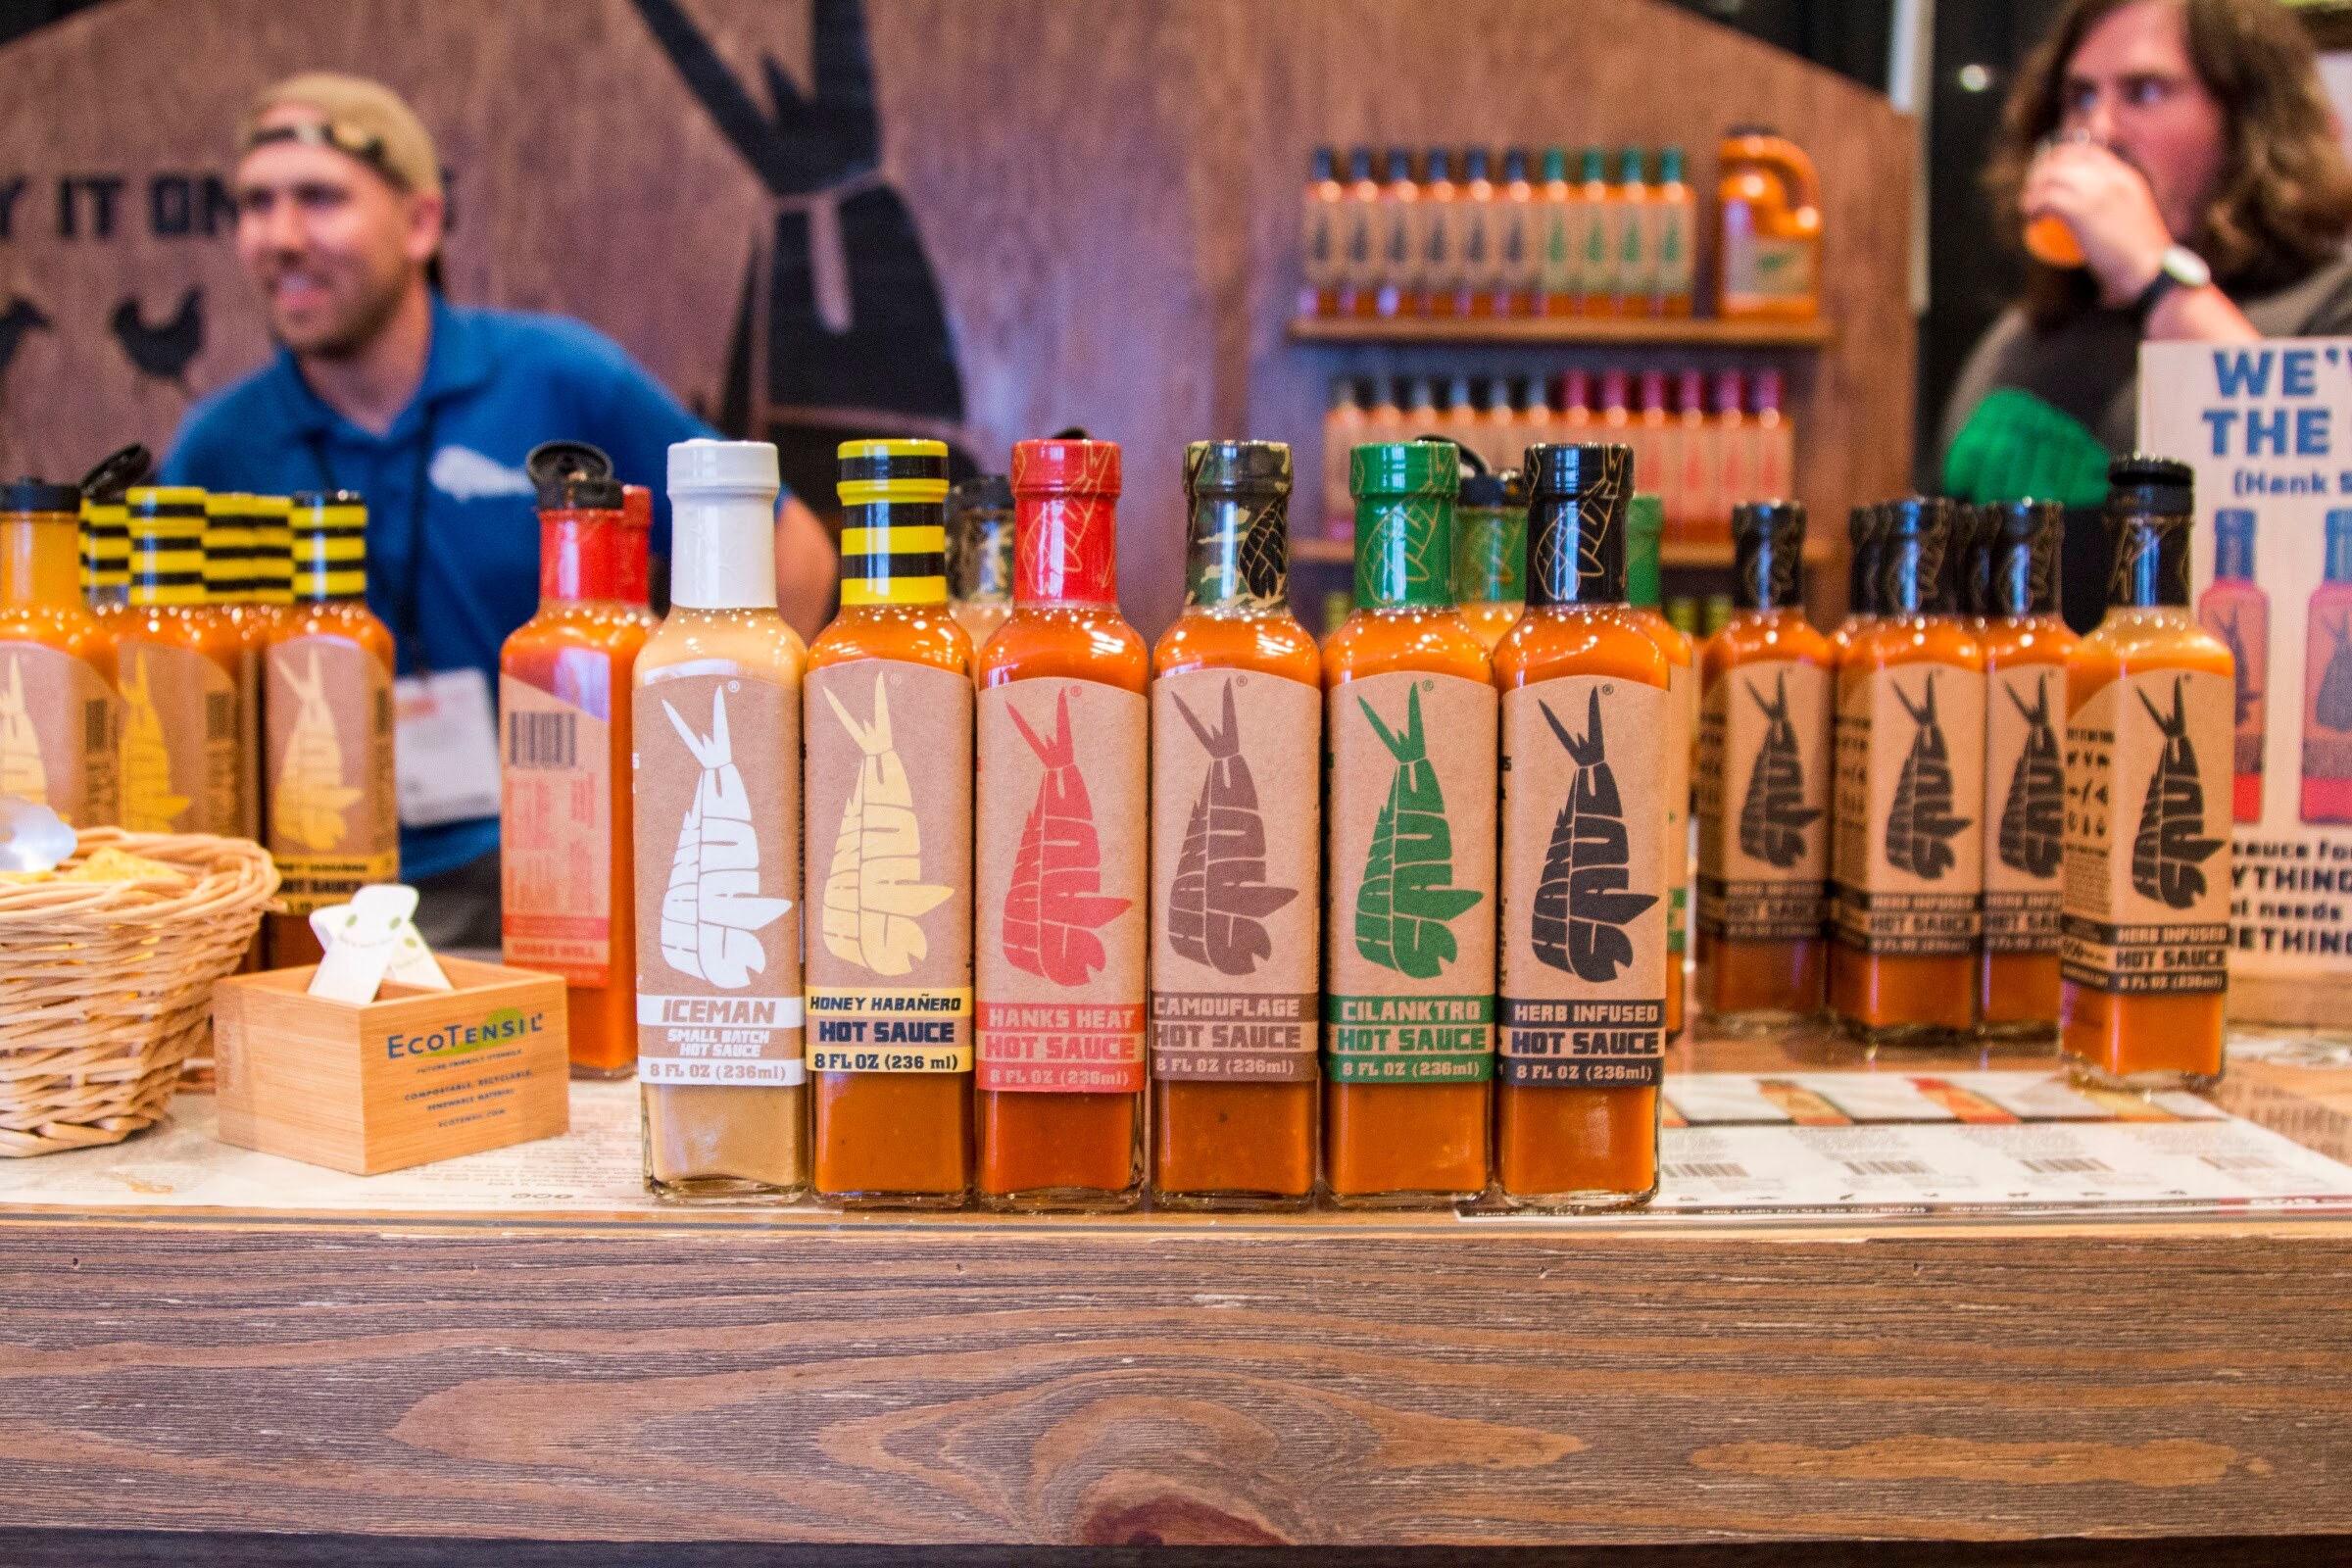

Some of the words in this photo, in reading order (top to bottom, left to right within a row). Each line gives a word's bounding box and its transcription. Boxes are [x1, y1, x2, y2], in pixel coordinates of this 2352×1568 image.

[59, 174, 125, 239] IT
[2202, 408, 2329, 456] THE
[2117, 951, 2155, 967] HOT
[2163, 951, 2225, 966] SAUCE
[810, 996, 867, 1010] HONEY
[870, 993, 961, 1011] HABAÑERO
[1153, 997, 1299, 1017] CAMOUFLAGE
[1342, 1001, 1481, 1021] CILANKTRO
[662, 1000, 776, 1024] ICEMAN
[989, 1008, 1070, 1028] HANKS
[1077, 1009, 1135, 1029] HEAT
[1514, 1004, 1568, 1022] HERB
[1573, 1005, 1658, 1022] INFUSED
[667, 1029, 718, 1042] SMALL
[721, 1031, 770, 1044] BATCH
[819, 1021, 867, 1043] HOT
[874, 1022, 955, 1043] SAUCE
[1152, 1024, 1204, 1048] HOT
[1212, 1025, 1300, 1049] SAUCE
[1338, 1029, 1391, 1052] HOT
[1398, 1029, 1486, 1051] SAUCE
[679, 1044, 710, 1056] HOT
[712, 1044, 760, 1057] SAUCE
[985, 1035, 1039, 1058] HOT
[1047, 1036, 1135, 1059] SAUCE
[1512, 1032, 1566, 1054] HOT
[1572, 1032, 1658, 1054] SAUCE
[814, 1054, 825, 1069] 8
[829, 1054, 852, 1069] FL
[856, 1054, 879, 1069] OZ
[885, 1054, 924, 1070] (236
[930, 1054, 957, 1070] ml)
[1156, 1058, 1167, 1071] 8
[1171, 1058, 1192, 1072] FL
[1197, 1058, 1219, 1072] OZ
[1226, 1059, 1295, 1075] (236ml)
[1343, 1062, 1353, 1076] 8
[1358, 1062, 1379, 1076] FL
[1412, 1061, 1480, 1078] (236ml)
[650, 1063, 660, 1077] 8
[664, 1064, 684, 1077] FL
[690, 1064, 710, 1078] OZ
[716, 1065, 786, 1082] (236ml)
[990, 1069, 1001, 1083] 8
[1005, 1070, 1026, 1083] FL
[1516, 1065, 1528, 1079] 8
[1532, 1065, 1552, 1079] FL
[1557, 1065, 1579, 1079] OZ
[1586, 1065, 1652, 1082] (236ml)
